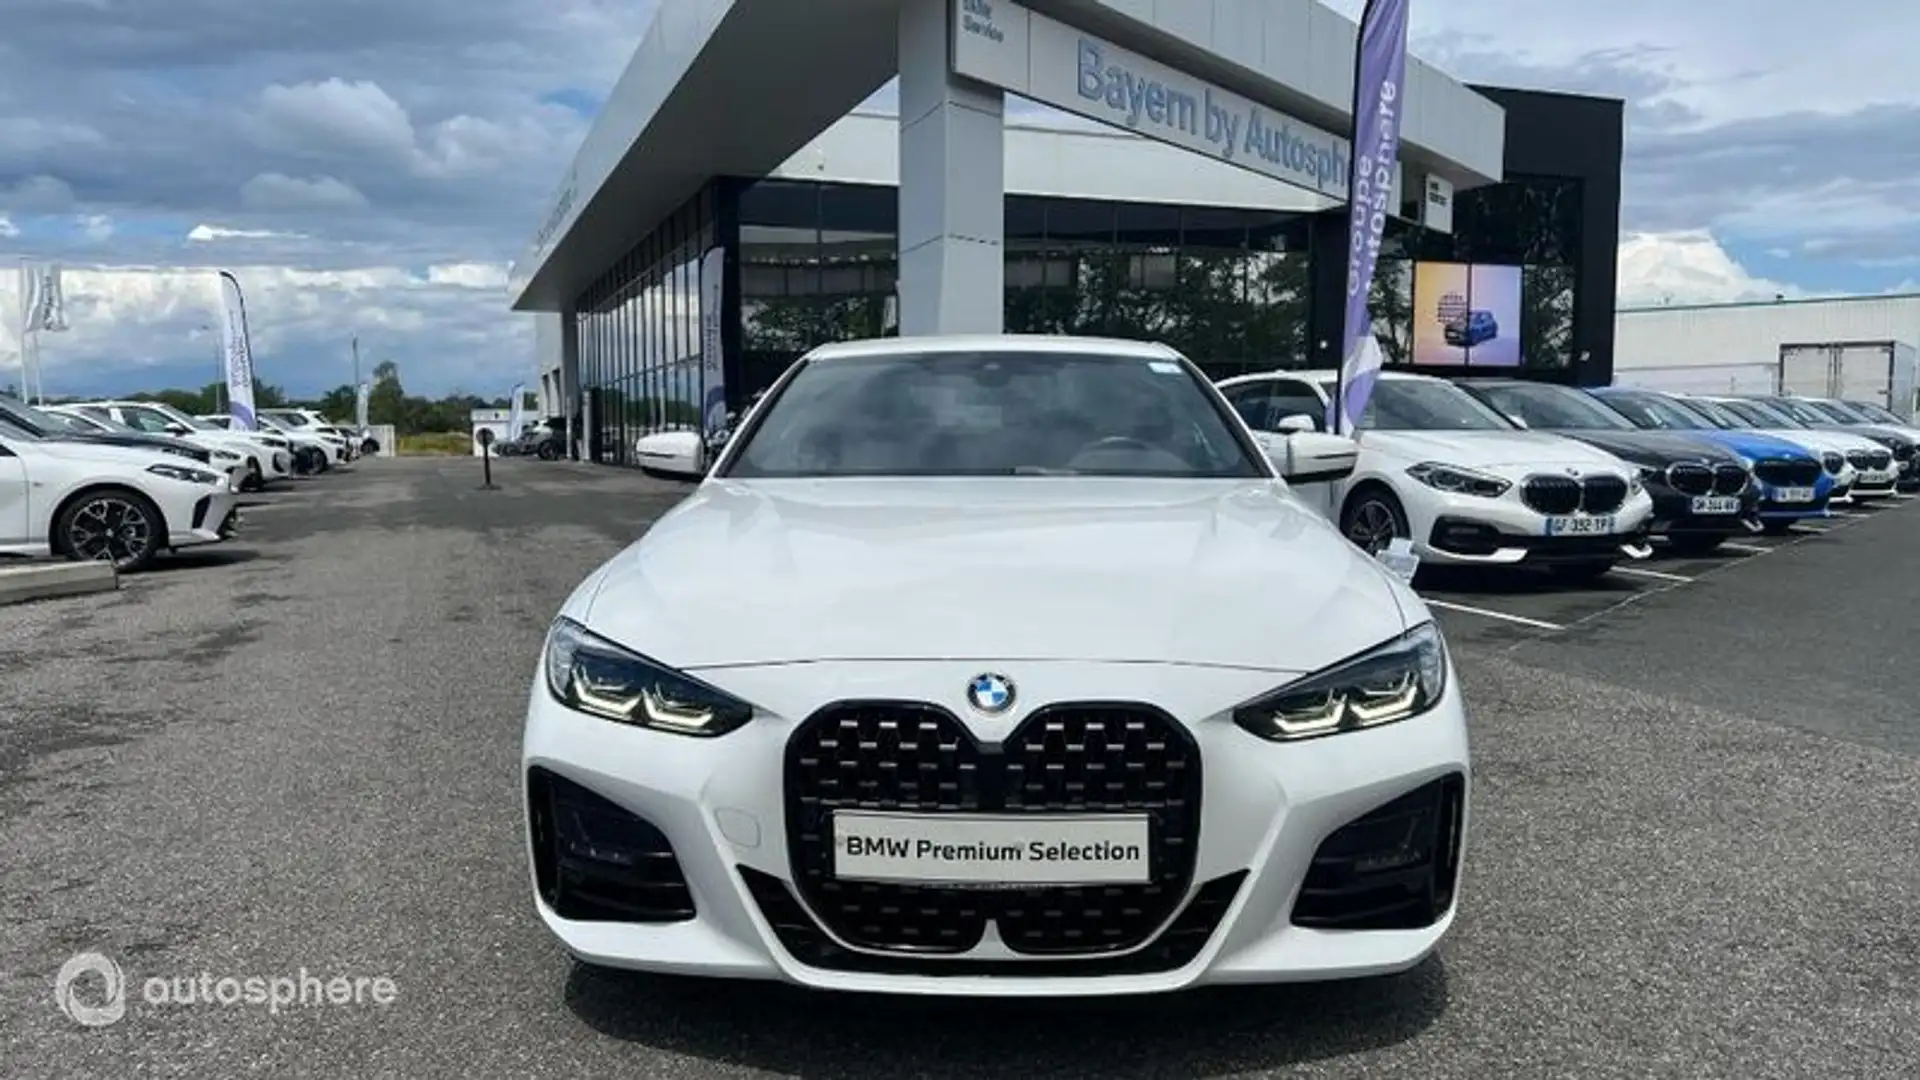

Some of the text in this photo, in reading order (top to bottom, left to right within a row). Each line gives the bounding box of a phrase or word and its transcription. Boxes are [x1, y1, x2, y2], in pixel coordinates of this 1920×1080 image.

[1078, 37, 1348, 189] Bayern by Autosph
[846, 836, 1140, 862] BMW Premium Selection
